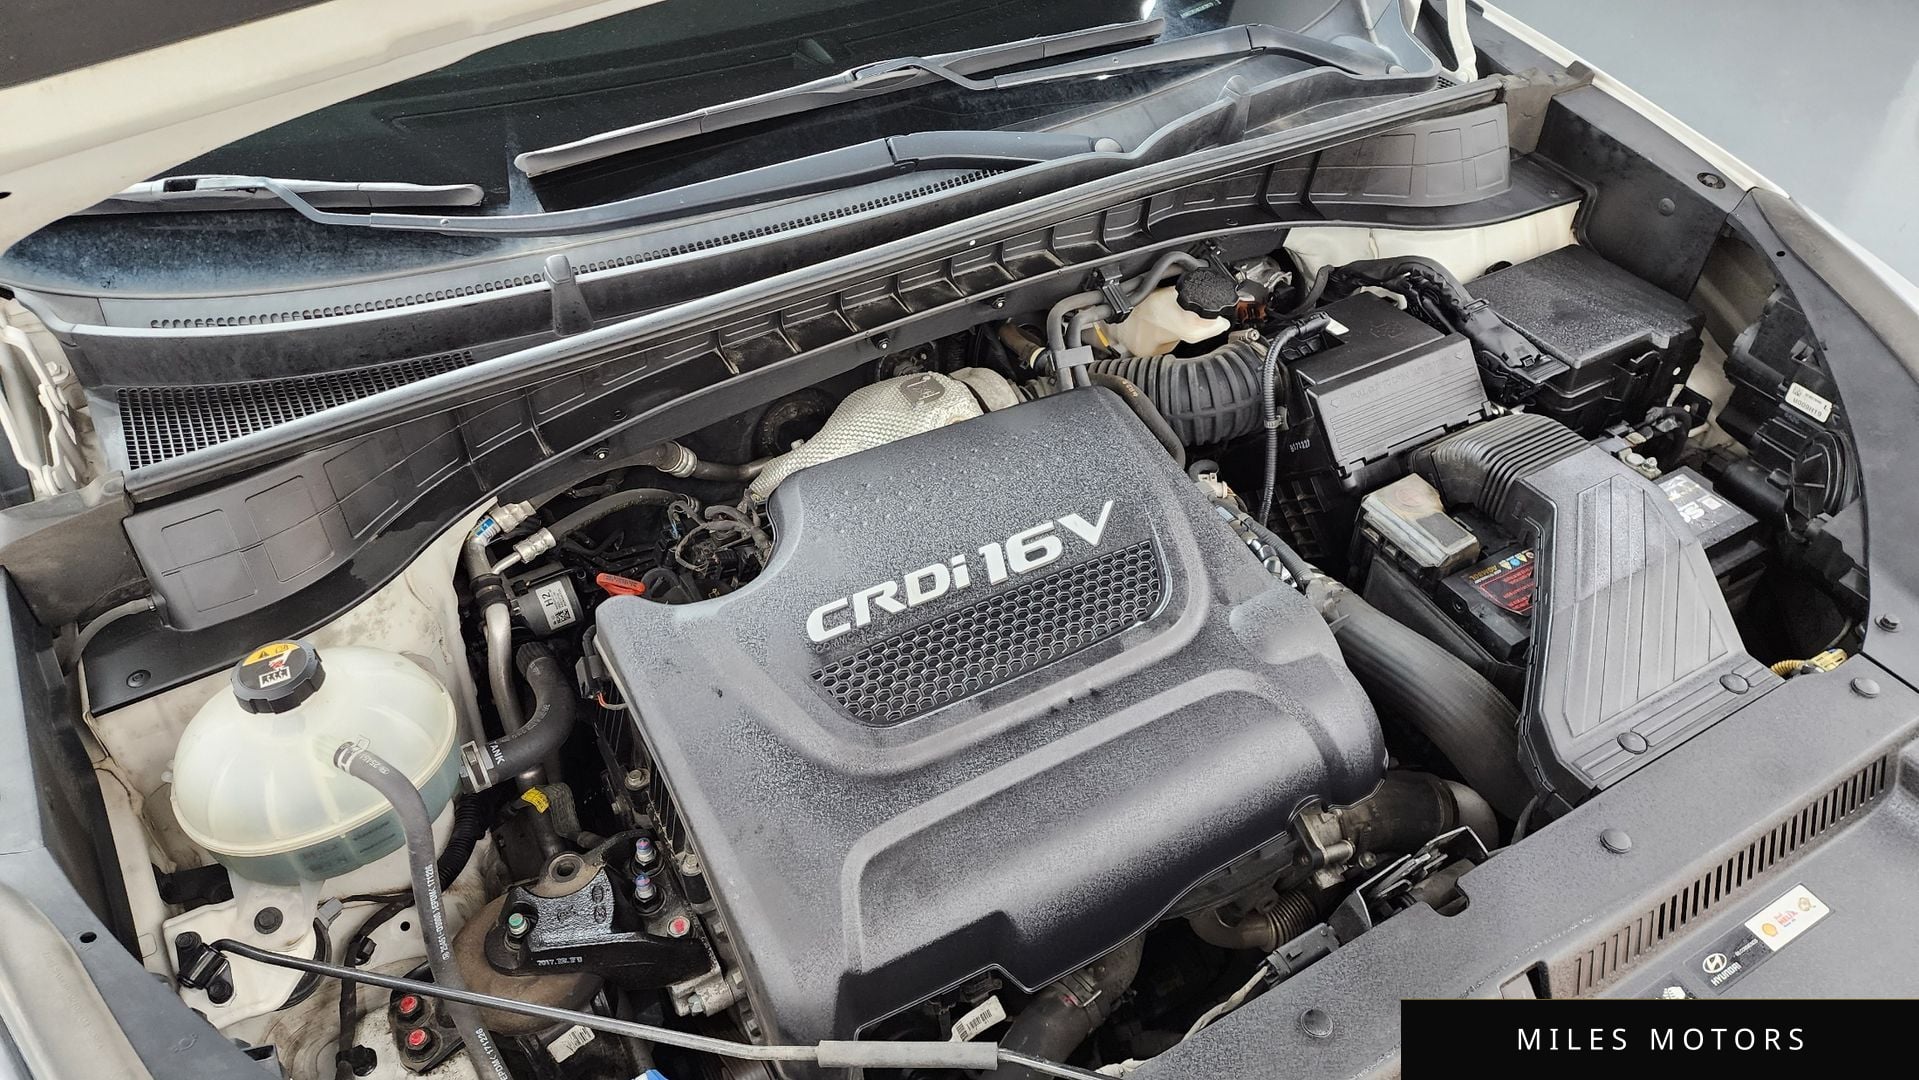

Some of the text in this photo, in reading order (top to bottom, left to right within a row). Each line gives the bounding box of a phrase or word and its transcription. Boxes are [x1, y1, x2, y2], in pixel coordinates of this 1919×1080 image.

[806, 554, 971, 643] CRDi
[978, 500, 1114, 586] 16V
[541, 591, 554, 607] H2
[1711, 962, 1742, 986] HYUNDAI
[475, 1027, 494, 1055] 171226
